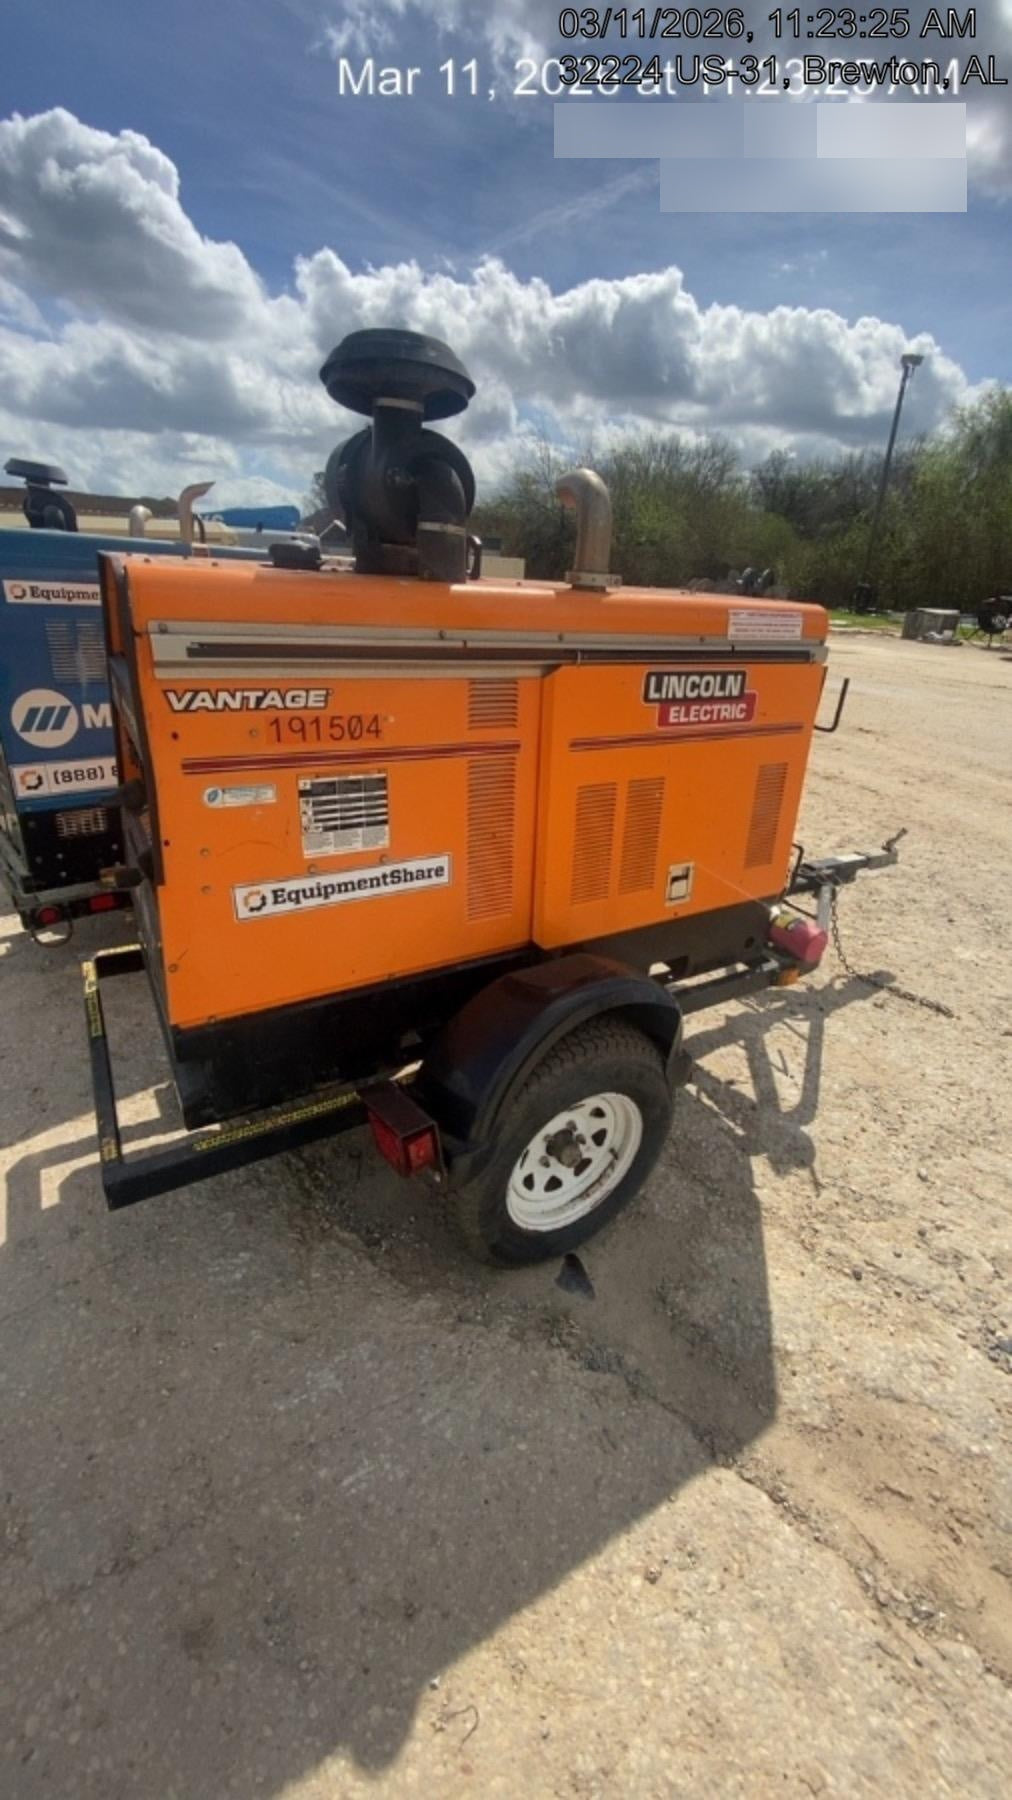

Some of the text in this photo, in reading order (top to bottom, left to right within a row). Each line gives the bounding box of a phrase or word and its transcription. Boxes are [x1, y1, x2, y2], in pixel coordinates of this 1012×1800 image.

[649, 674, 743, 700] LINCOLN
[164, 688, 328, 712] VANTAGE
[669, 702, 747, 723] ELECTRIC
[269, 714, 383, 743] 191504
[53, 765, 105, 784] (888)
[271, 865, 446, 905] EquipmentShare
